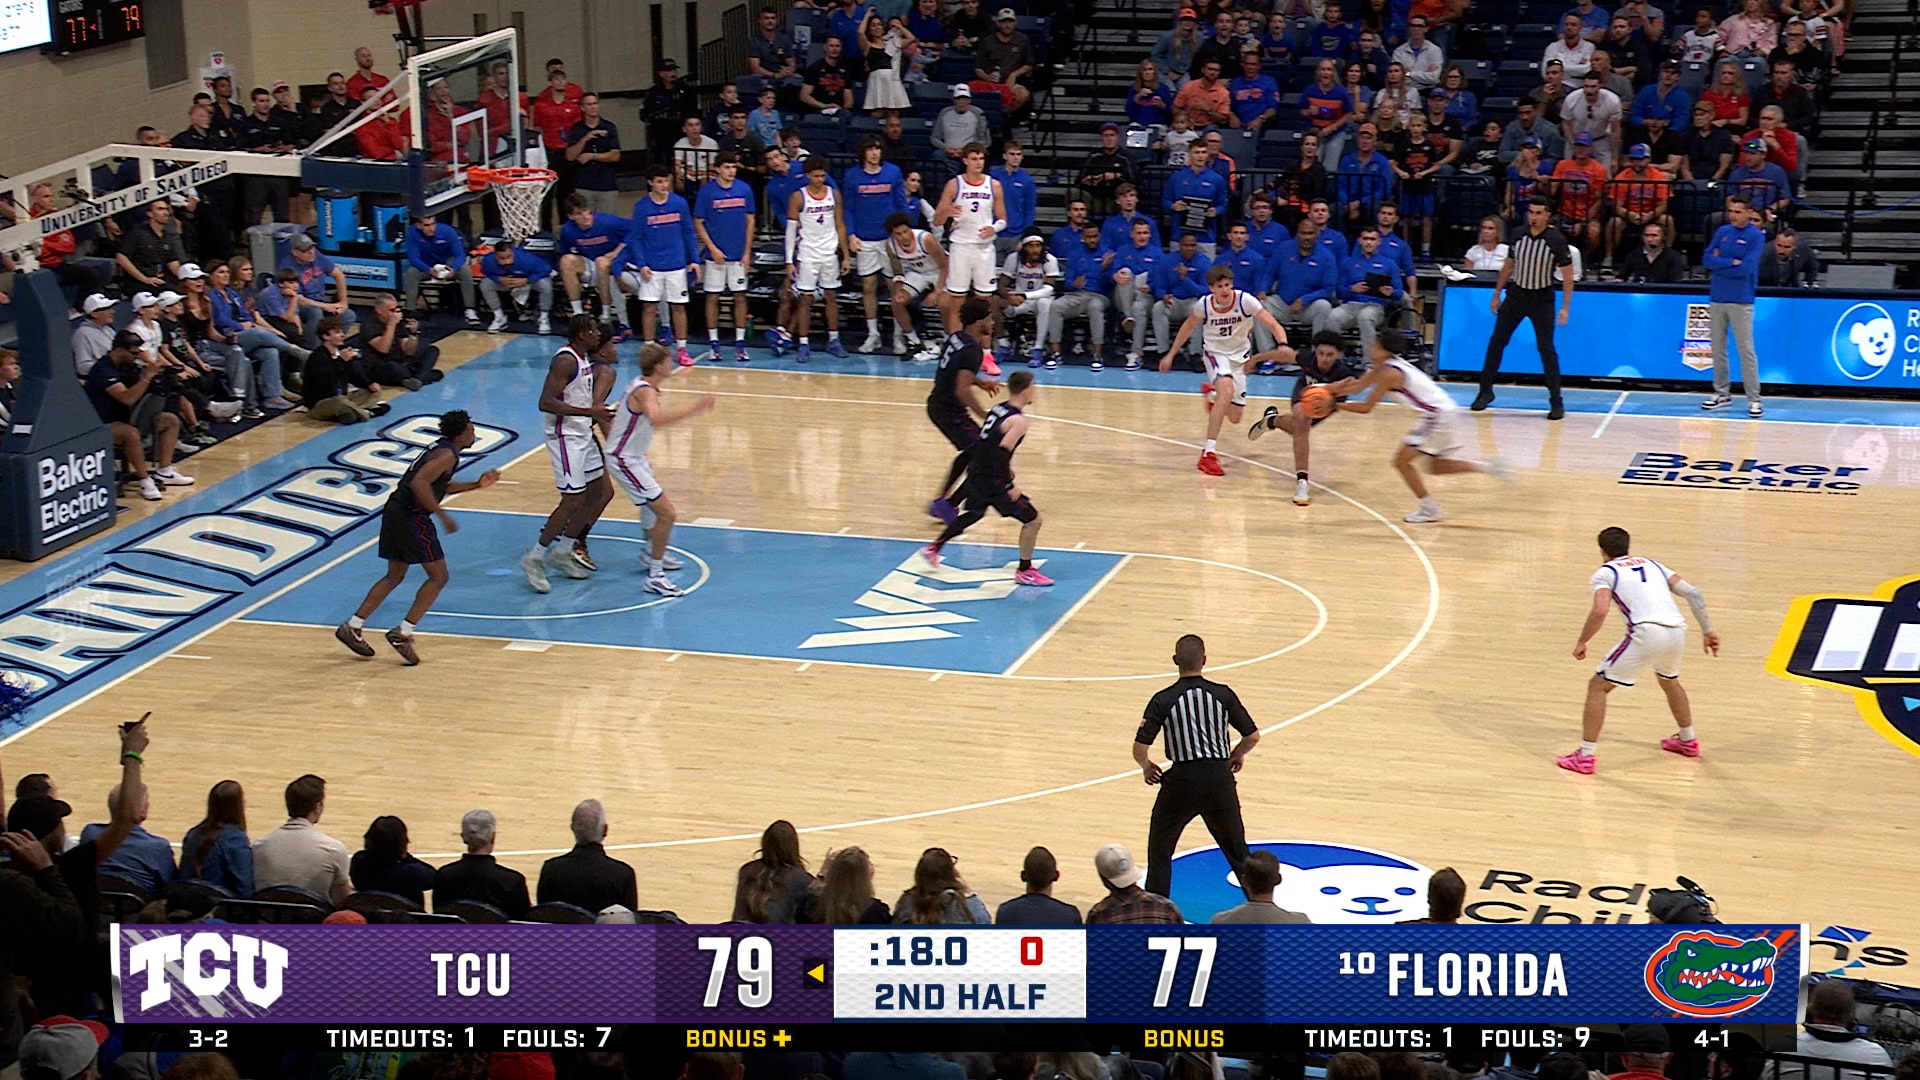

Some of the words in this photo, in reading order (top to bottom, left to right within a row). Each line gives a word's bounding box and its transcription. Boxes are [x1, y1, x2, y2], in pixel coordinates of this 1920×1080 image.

[66, 16, 87, 43] 77
[121, 5, 140, 31] 79
[41, 194, 128, 234] UNIVERSITY
[135, 187, 150, 203] OF
[157, 173, 187, 195] SAN
[191, 160, 228, 183] DIEGO
[961, 192, 990, 200] FLORIDA
[971, 201, 979, 213] 3
[816, 213, 825, 225] 4
[1210, 316, 1242, 326] FLORIDA
[1219, 326, 1233, 337] 21
[1904, 334, 1920, 353] C
[38, 449, 106, 499] Baker
[1628, 452, 1869, 477] Baker
[1621, 468, 1862, 491] Electric
[41, 485, 108, 531] Electric
[105, 413, 519, 586] DIEGO
[1631, 566, 1647, 583] 7
[1479, 869, 1647, 905] Rad
